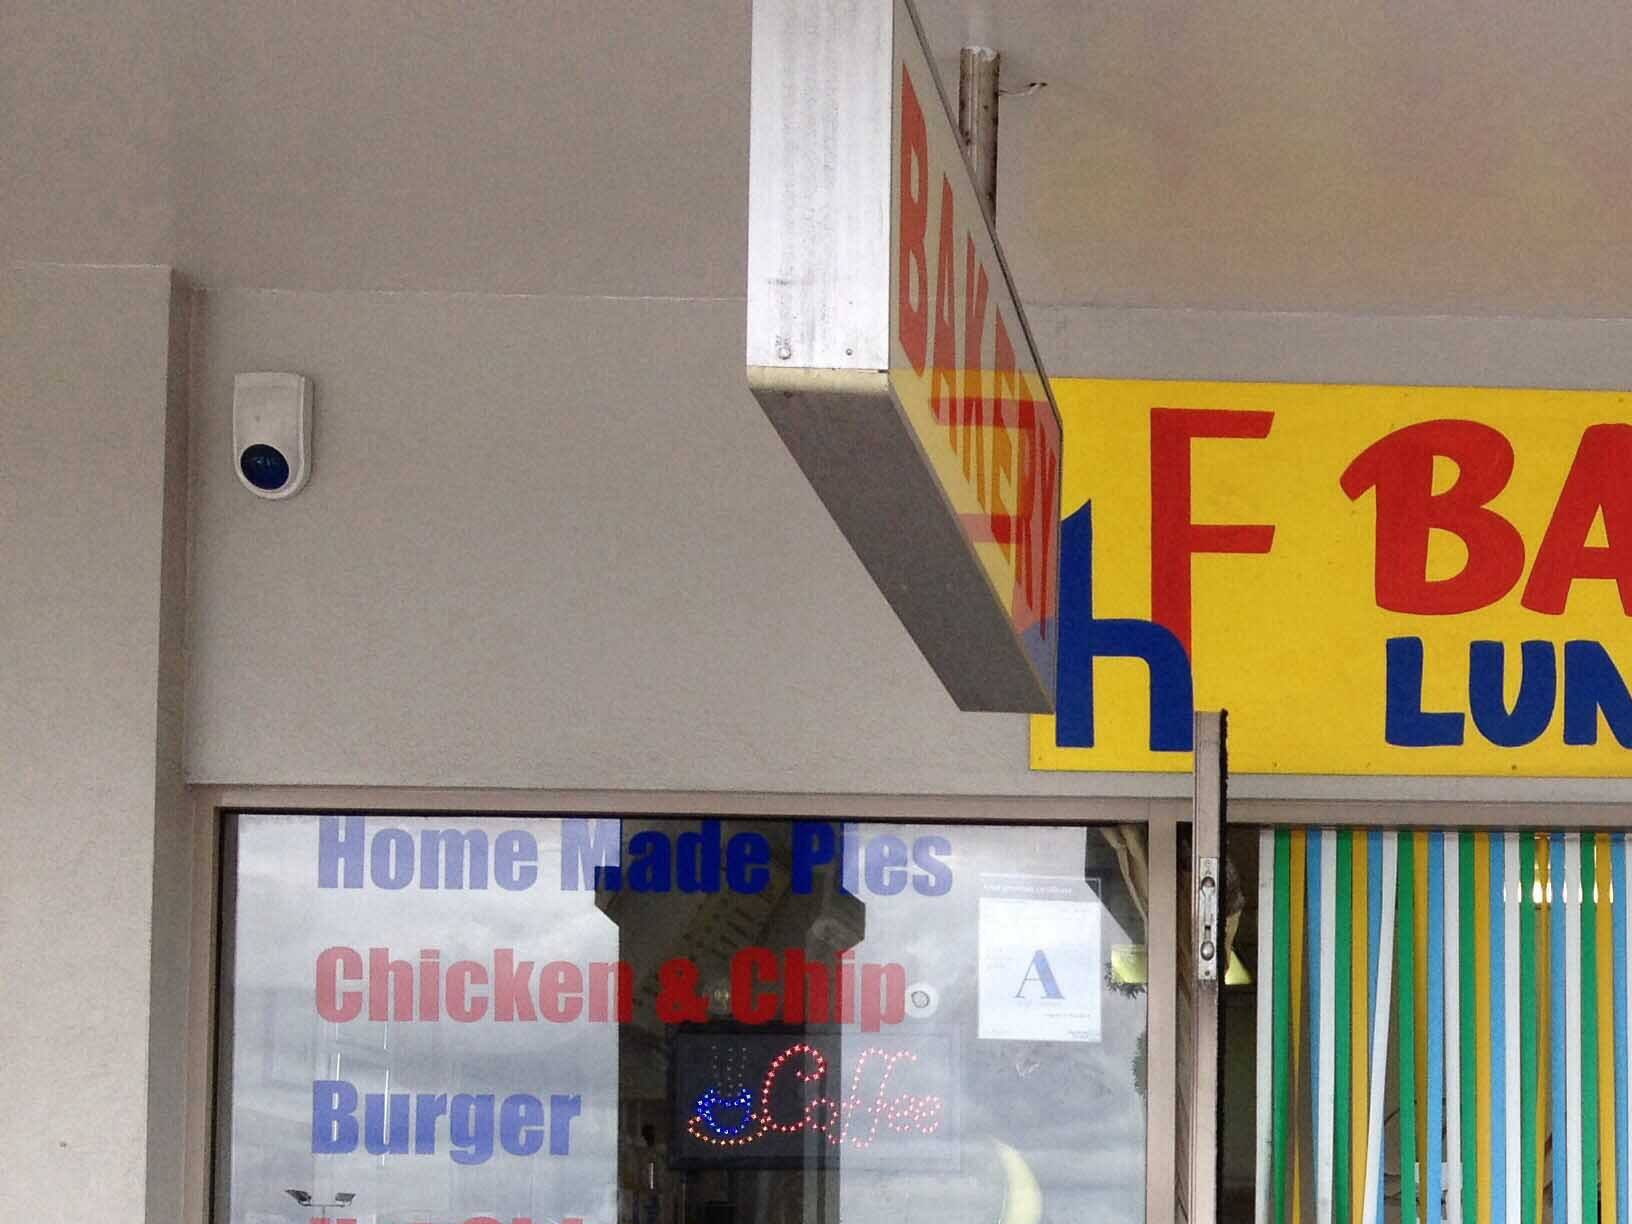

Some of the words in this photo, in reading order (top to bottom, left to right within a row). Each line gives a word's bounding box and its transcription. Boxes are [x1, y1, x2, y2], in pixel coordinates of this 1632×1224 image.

[317, 817, 538, 891] Home
[560, 818, 770, 895] Made
[792, 820, 952, 897] Pies
[315, 946, 633, 1024] Chicken
[658, 956, 707, 1024] &
[730, 945, 907, 1033] Chip
[1013, 949, 1067, 1000] A
[312, 1080, 580, 1164] Burger
